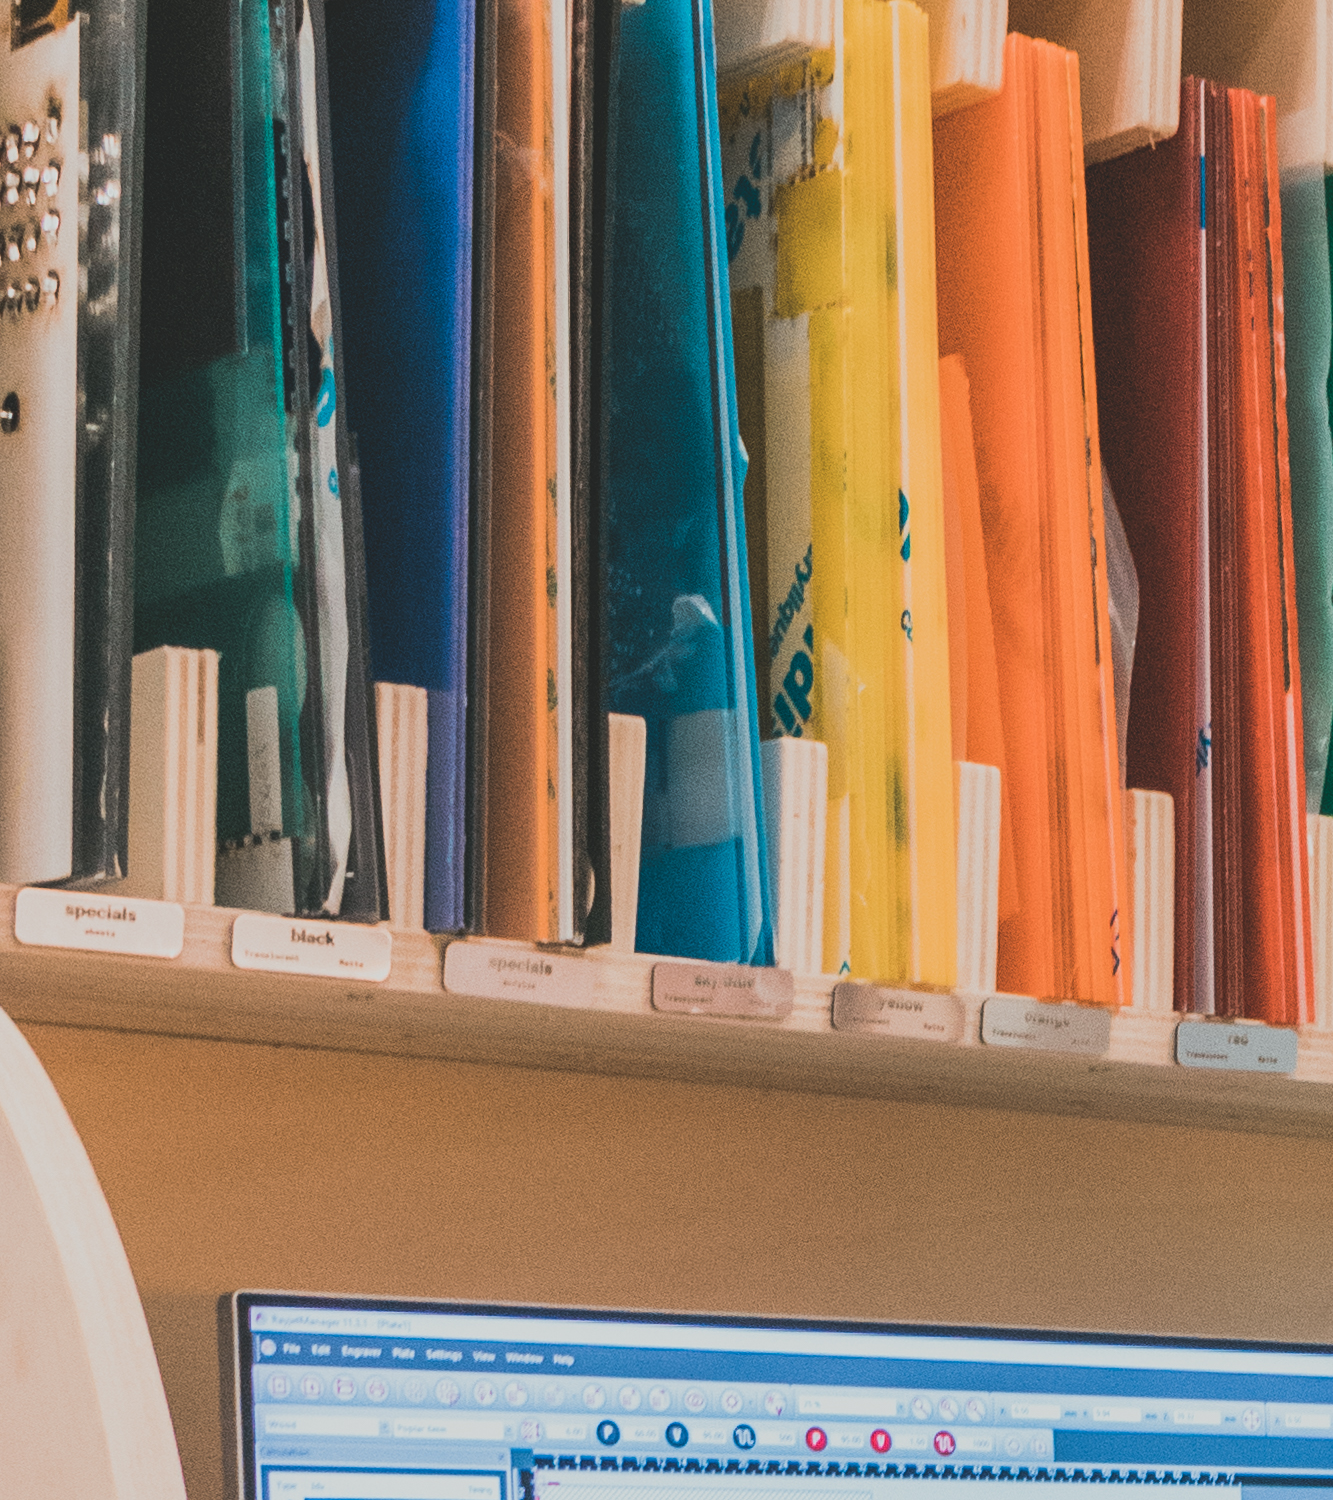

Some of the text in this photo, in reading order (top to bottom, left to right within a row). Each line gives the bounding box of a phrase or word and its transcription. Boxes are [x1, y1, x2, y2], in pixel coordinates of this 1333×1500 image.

[65, 904, 137, 922] specials
[290, 927, 335, 946] black
[488, 958, 553, 975] specials
[283, 1343, 301, 1356] File
[311, 1344, 331, 1357] Edit
[391, 1347, 416, 1360] Plate
[425, 1348, 463, 1363] Settings
[472, 1350, 496, 1363] View
[505, 1352, 544, 1365] Window
[553, 1354, 575, 1367] Help
